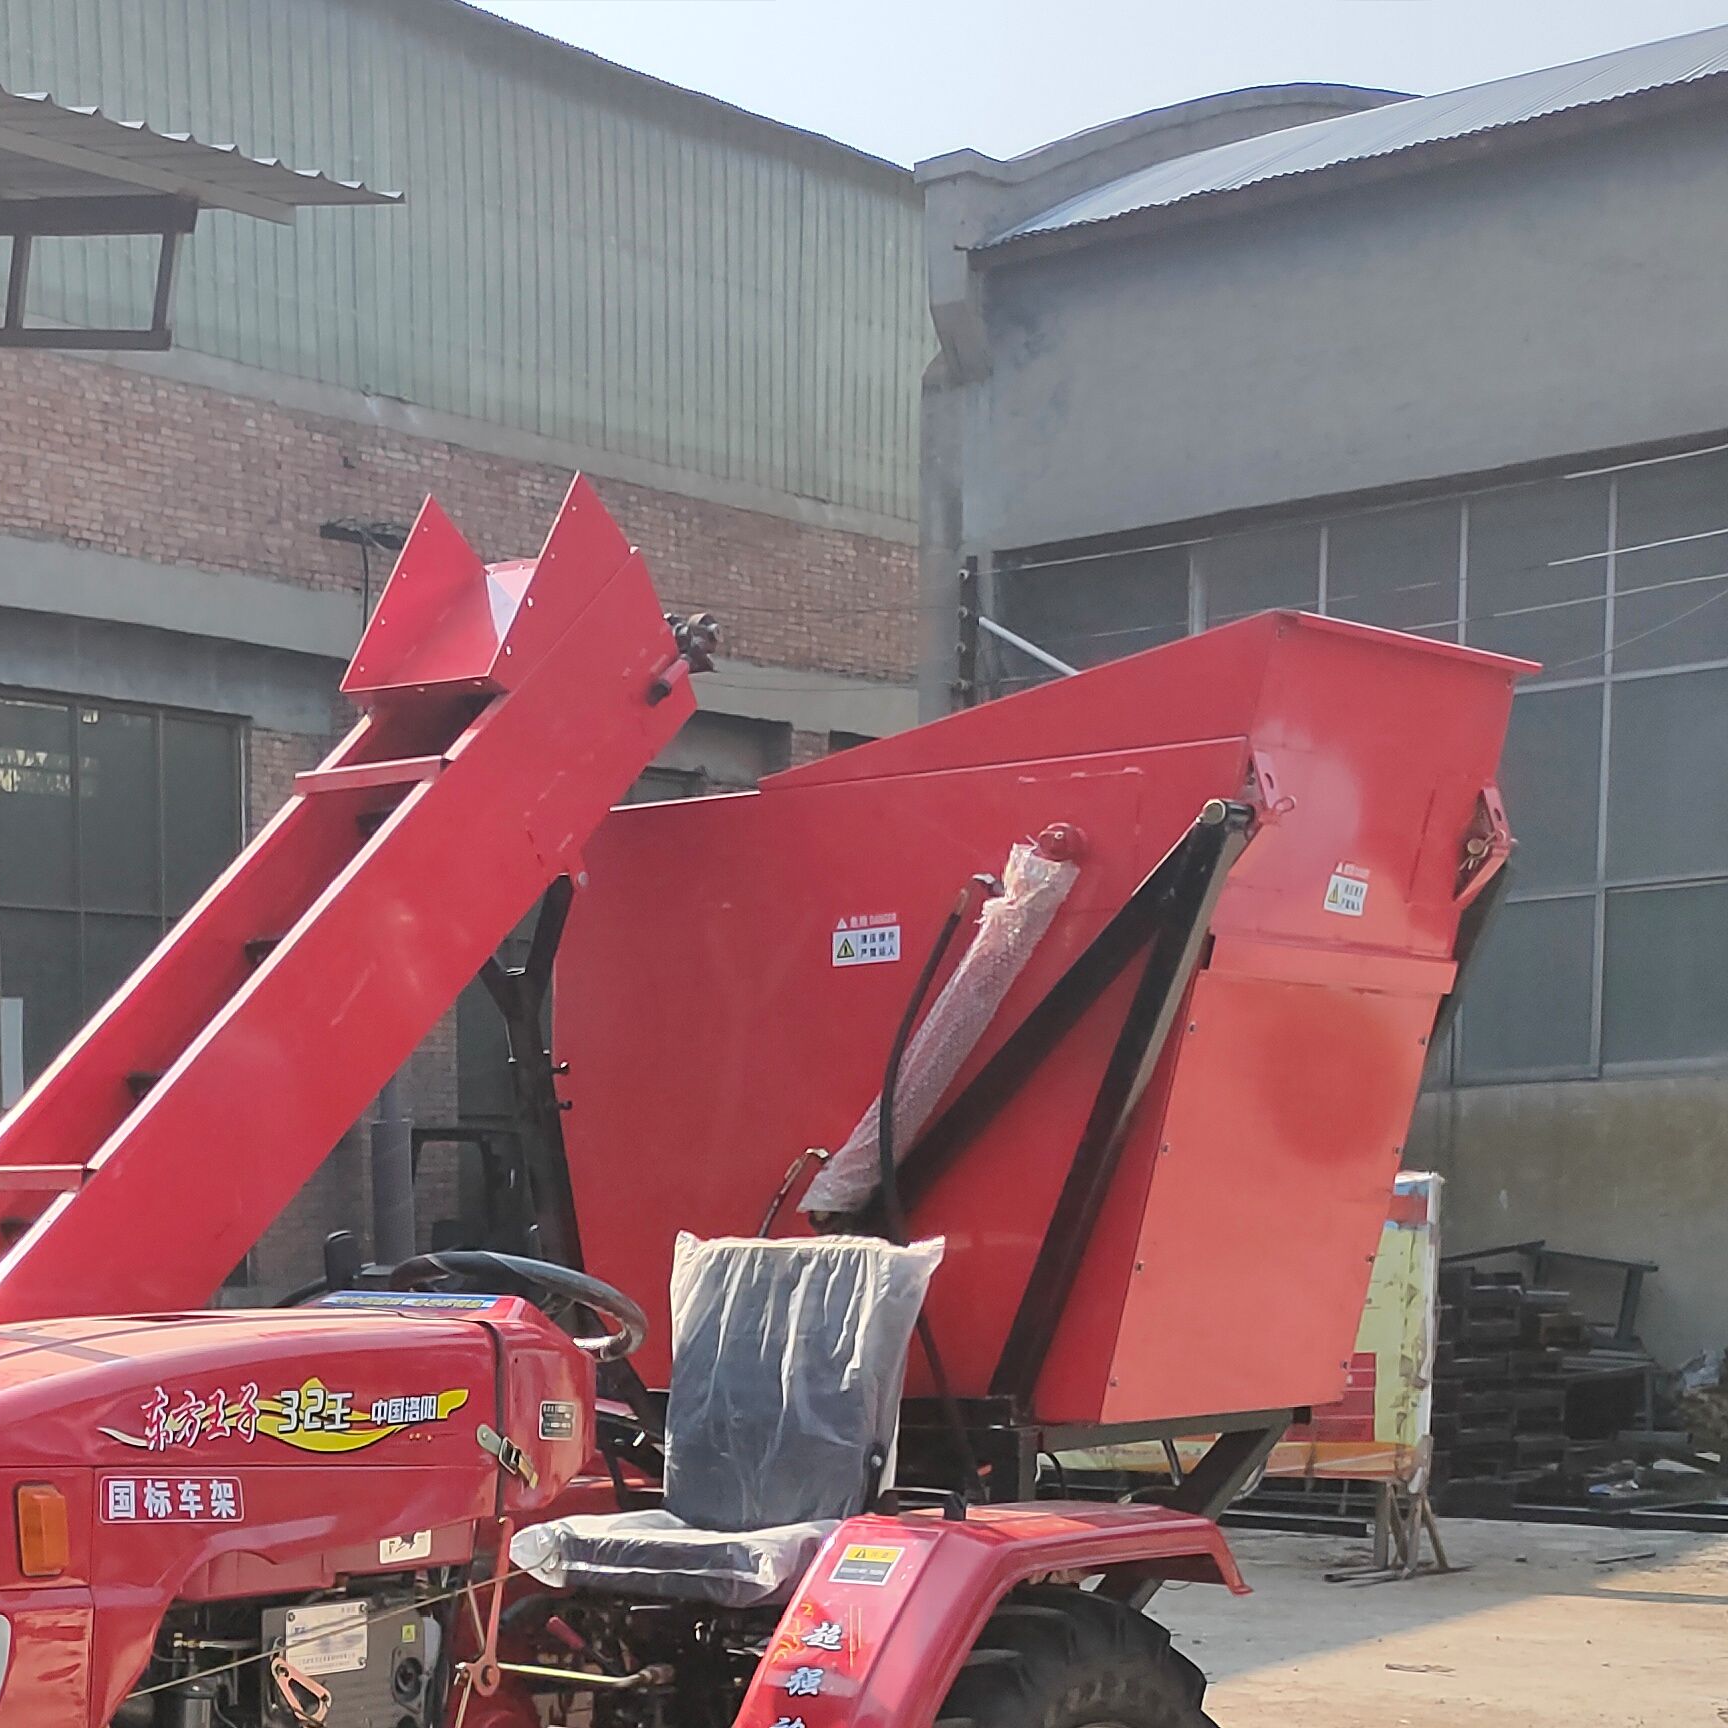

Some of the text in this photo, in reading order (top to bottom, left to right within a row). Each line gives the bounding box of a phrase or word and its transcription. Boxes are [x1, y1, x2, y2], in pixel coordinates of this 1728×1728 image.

[278, 1388, 354, 1433] 32王
[371, 1395, 438, 1426] 中国洛阳
[108, 1479, 237, 1519] 国标车架
